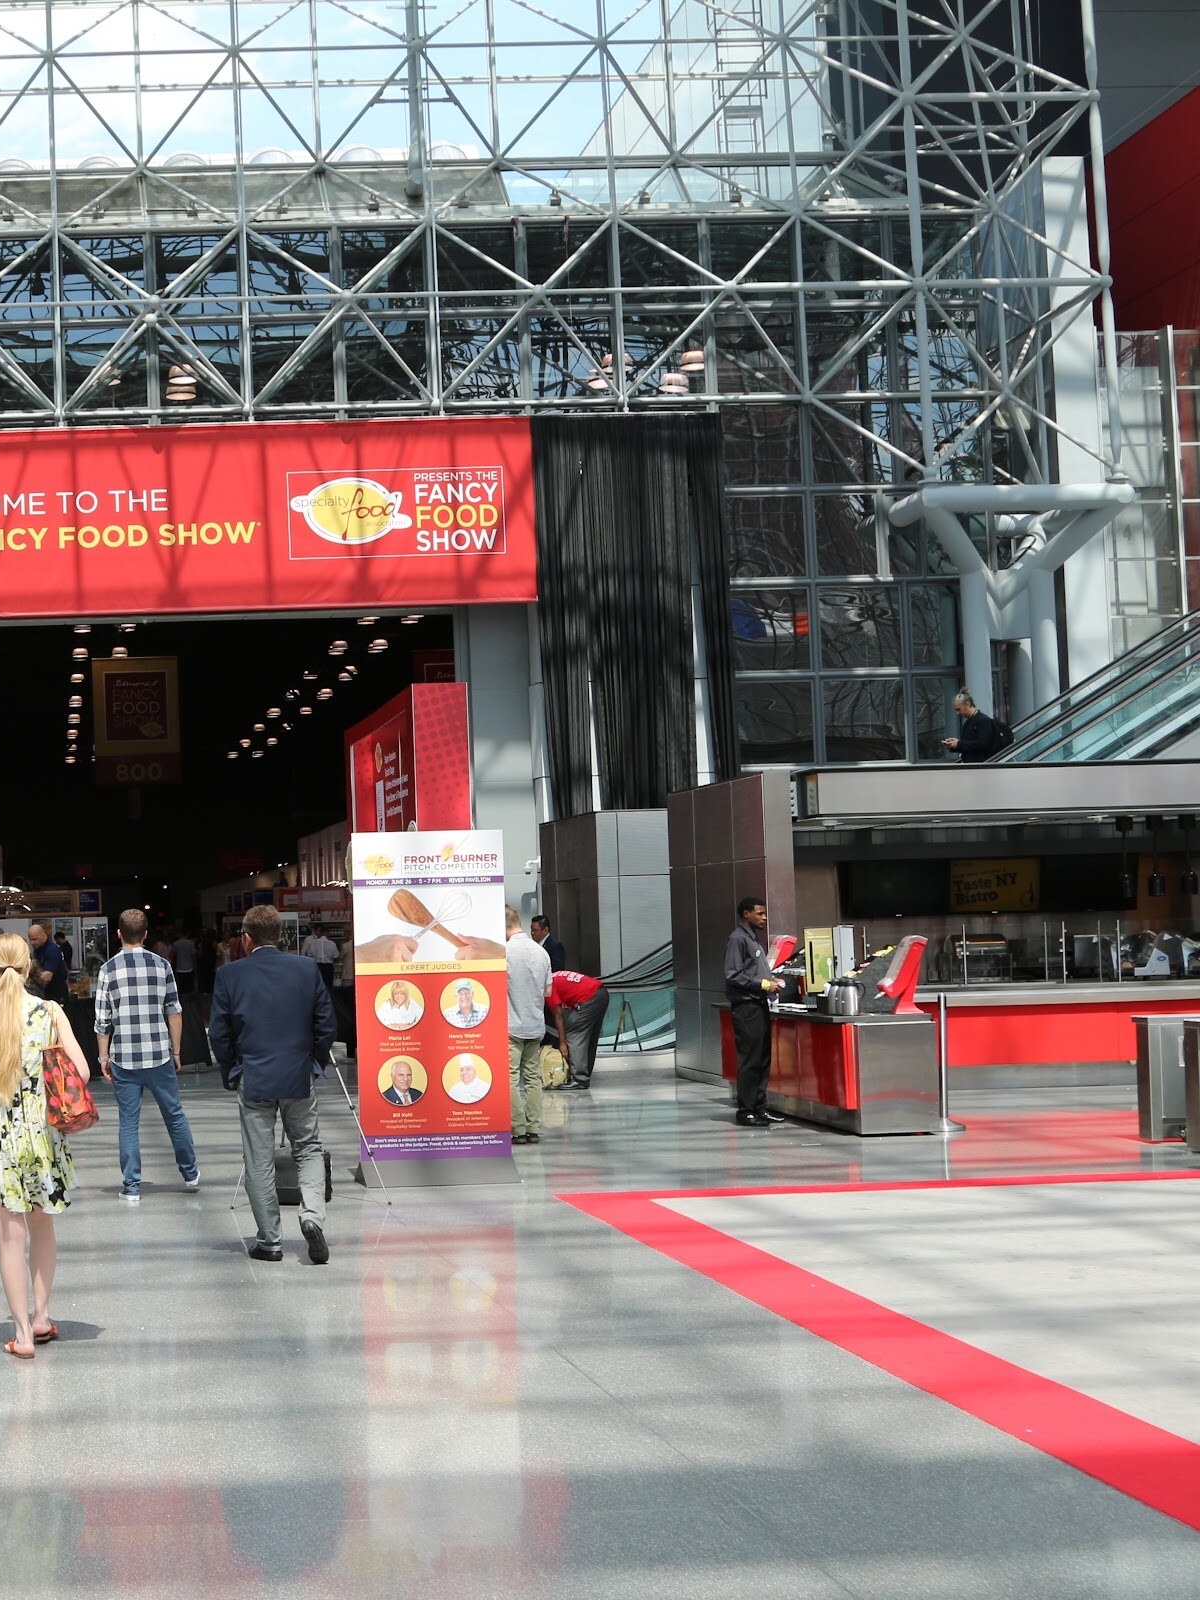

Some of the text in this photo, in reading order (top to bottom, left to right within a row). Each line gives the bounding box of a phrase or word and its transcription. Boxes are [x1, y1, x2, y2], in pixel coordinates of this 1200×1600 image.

[413, 471, 498, 483] PRESENTS THE
[414, 482, 498, 504] FANCY
[56, 491, 98, 515] TO
[108, 489, 169, 513] THE
[294, 496, 350, 509] specialty
[341, 488, 399, 541] food
[415, 503, 499, 529] FOOD
[59, 523, 149, 549] FOOD
[416, 529, 498, 552] SHOW
[112, 689, 160, 700] FANCY
[112, 701, 160, 714] FOOD
[112, 715, 160, 728] SHOW
[116, 762, 161, 782] 800
[404, 854, 498, 864] FRONT BURNER
[434, 862, 497, 870] COMPETITION
[952, 878, 992, 891] Taste
[996, 871, 1017, 887] NY
[955, 891, 998, 905] Bistro
